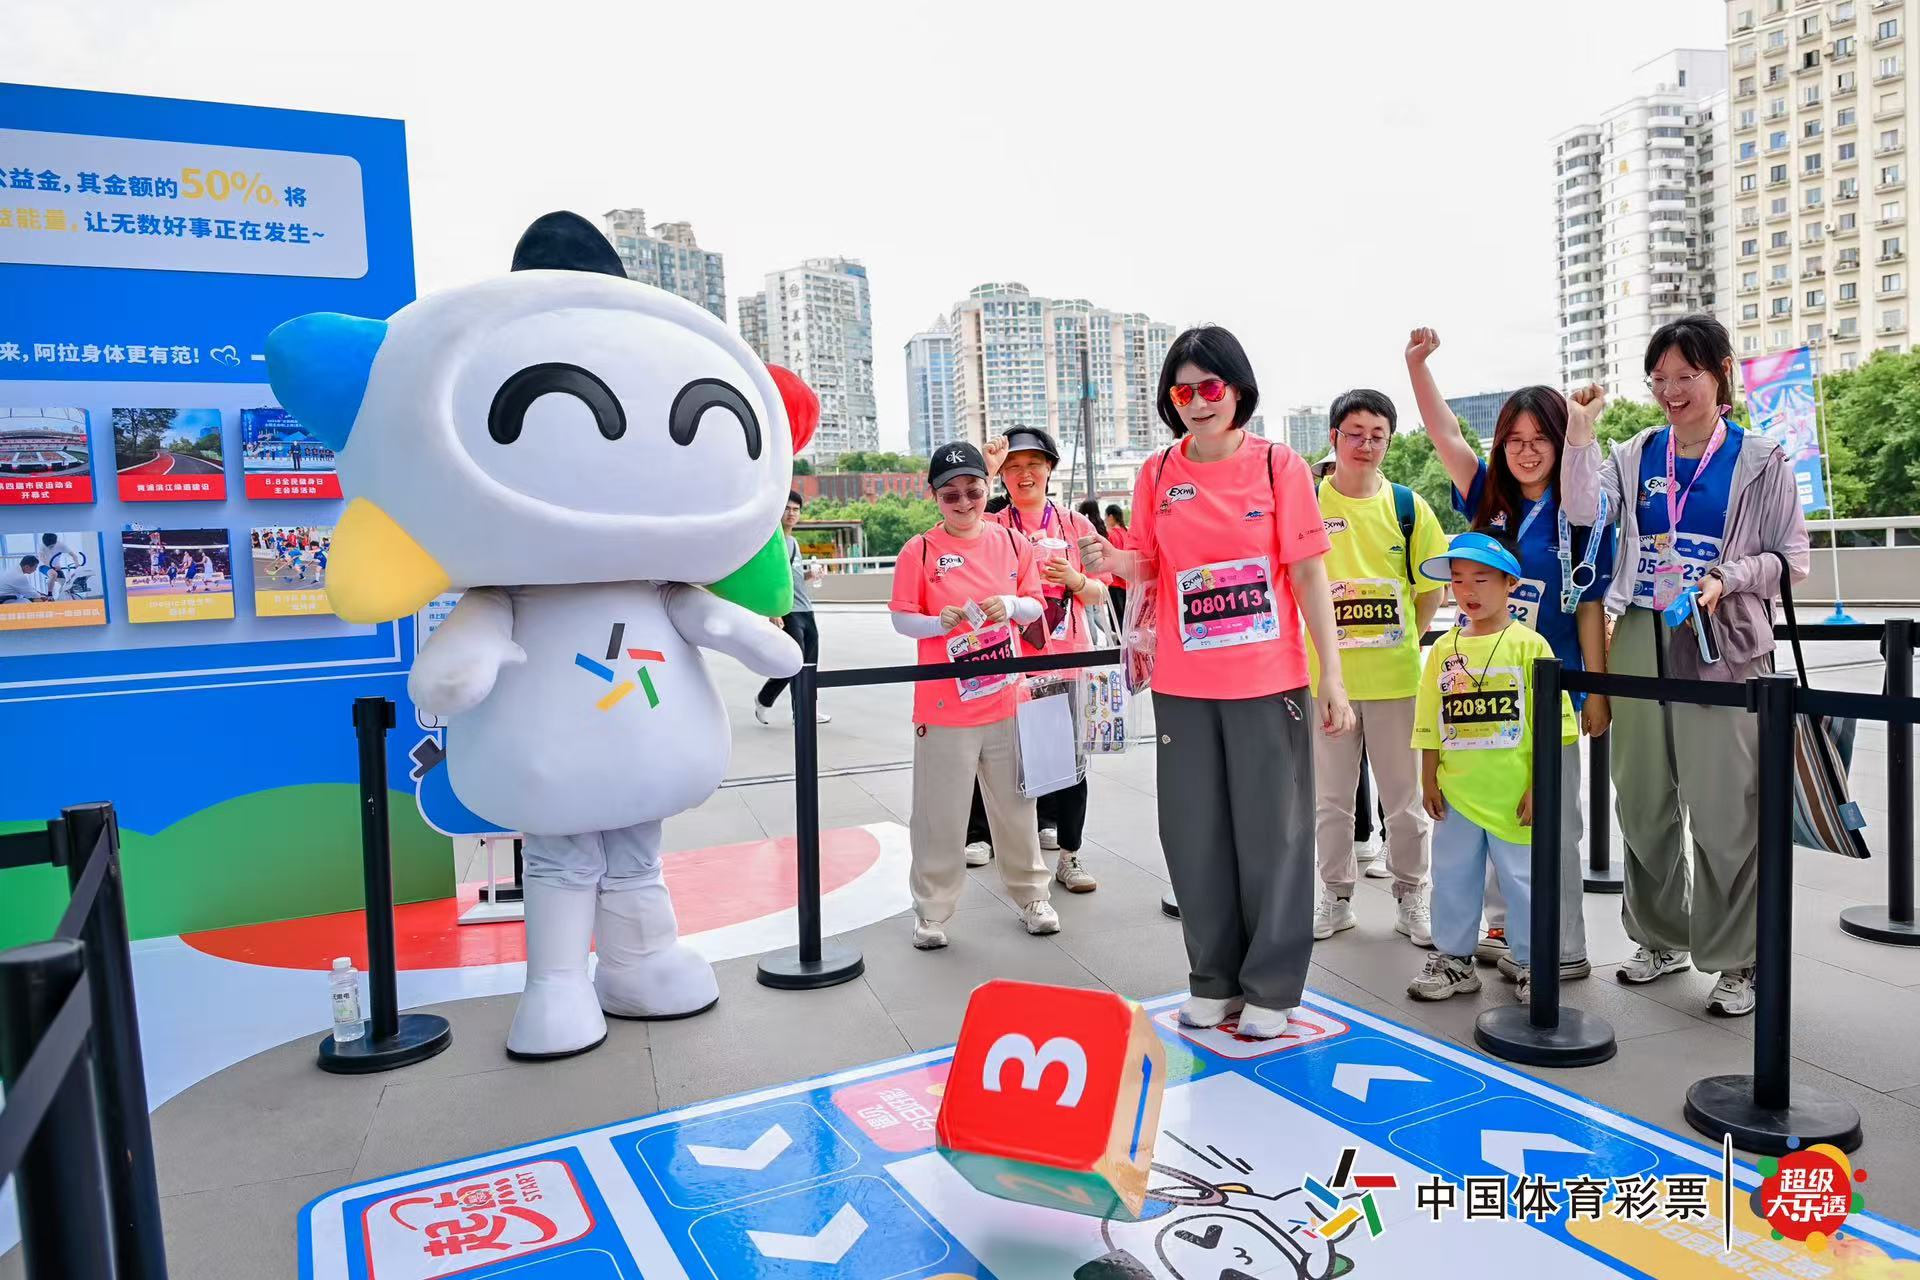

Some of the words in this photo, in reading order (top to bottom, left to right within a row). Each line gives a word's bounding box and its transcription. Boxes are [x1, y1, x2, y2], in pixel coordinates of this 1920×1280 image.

[1191, 589, 1263, 616] 080113
[1335, 604, 1393, 620] 120813
[1445, 696, 1512, 717] 120812
[983, 1033, 1088, 1109] 3
[515, 1171, 543, 1203] START
